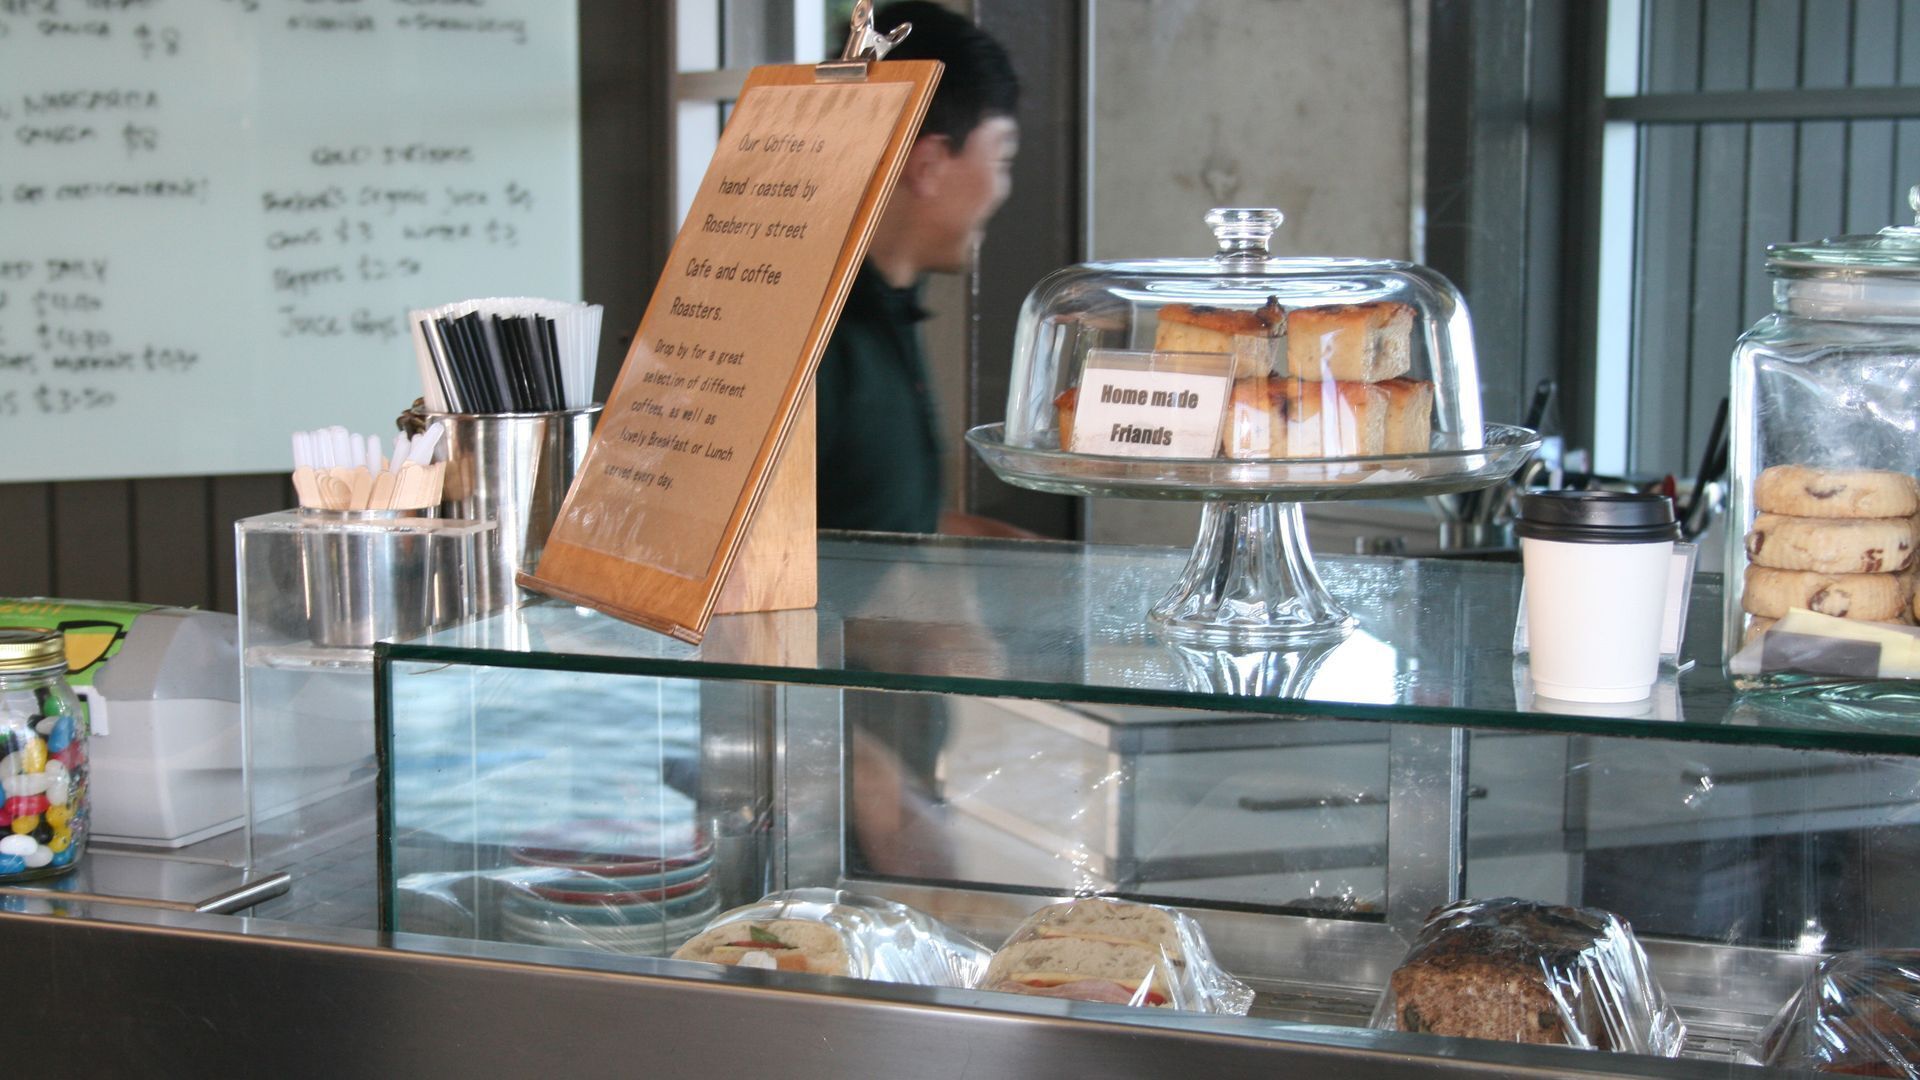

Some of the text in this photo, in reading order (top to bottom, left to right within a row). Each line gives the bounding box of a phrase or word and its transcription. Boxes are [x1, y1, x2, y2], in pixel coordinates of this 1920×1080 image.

[737, 132, 825, 152] Our Coffee is
[718, 175, 819, 202] hand roasted by
[702, 213, 808, 239] Roseberry street
[685, 257, 782, 285] Cafe and coffee
[670, 296, 723, 321] Roasters.
[654, 338, 745, 366] Drop by for a great
[642, 370, 746, 399] selection of different
[1100, 383, 1199, 409] Home made
[668, 406, 680, 418] as
[682, 407, 704, 422] well
[704, 413, 718, 425] as
[619, 426, 733, 462] lovely Breakfast or Lunch
[1109, 422, 1173, 446] Friands
[656, 471, 674, 491] day.
